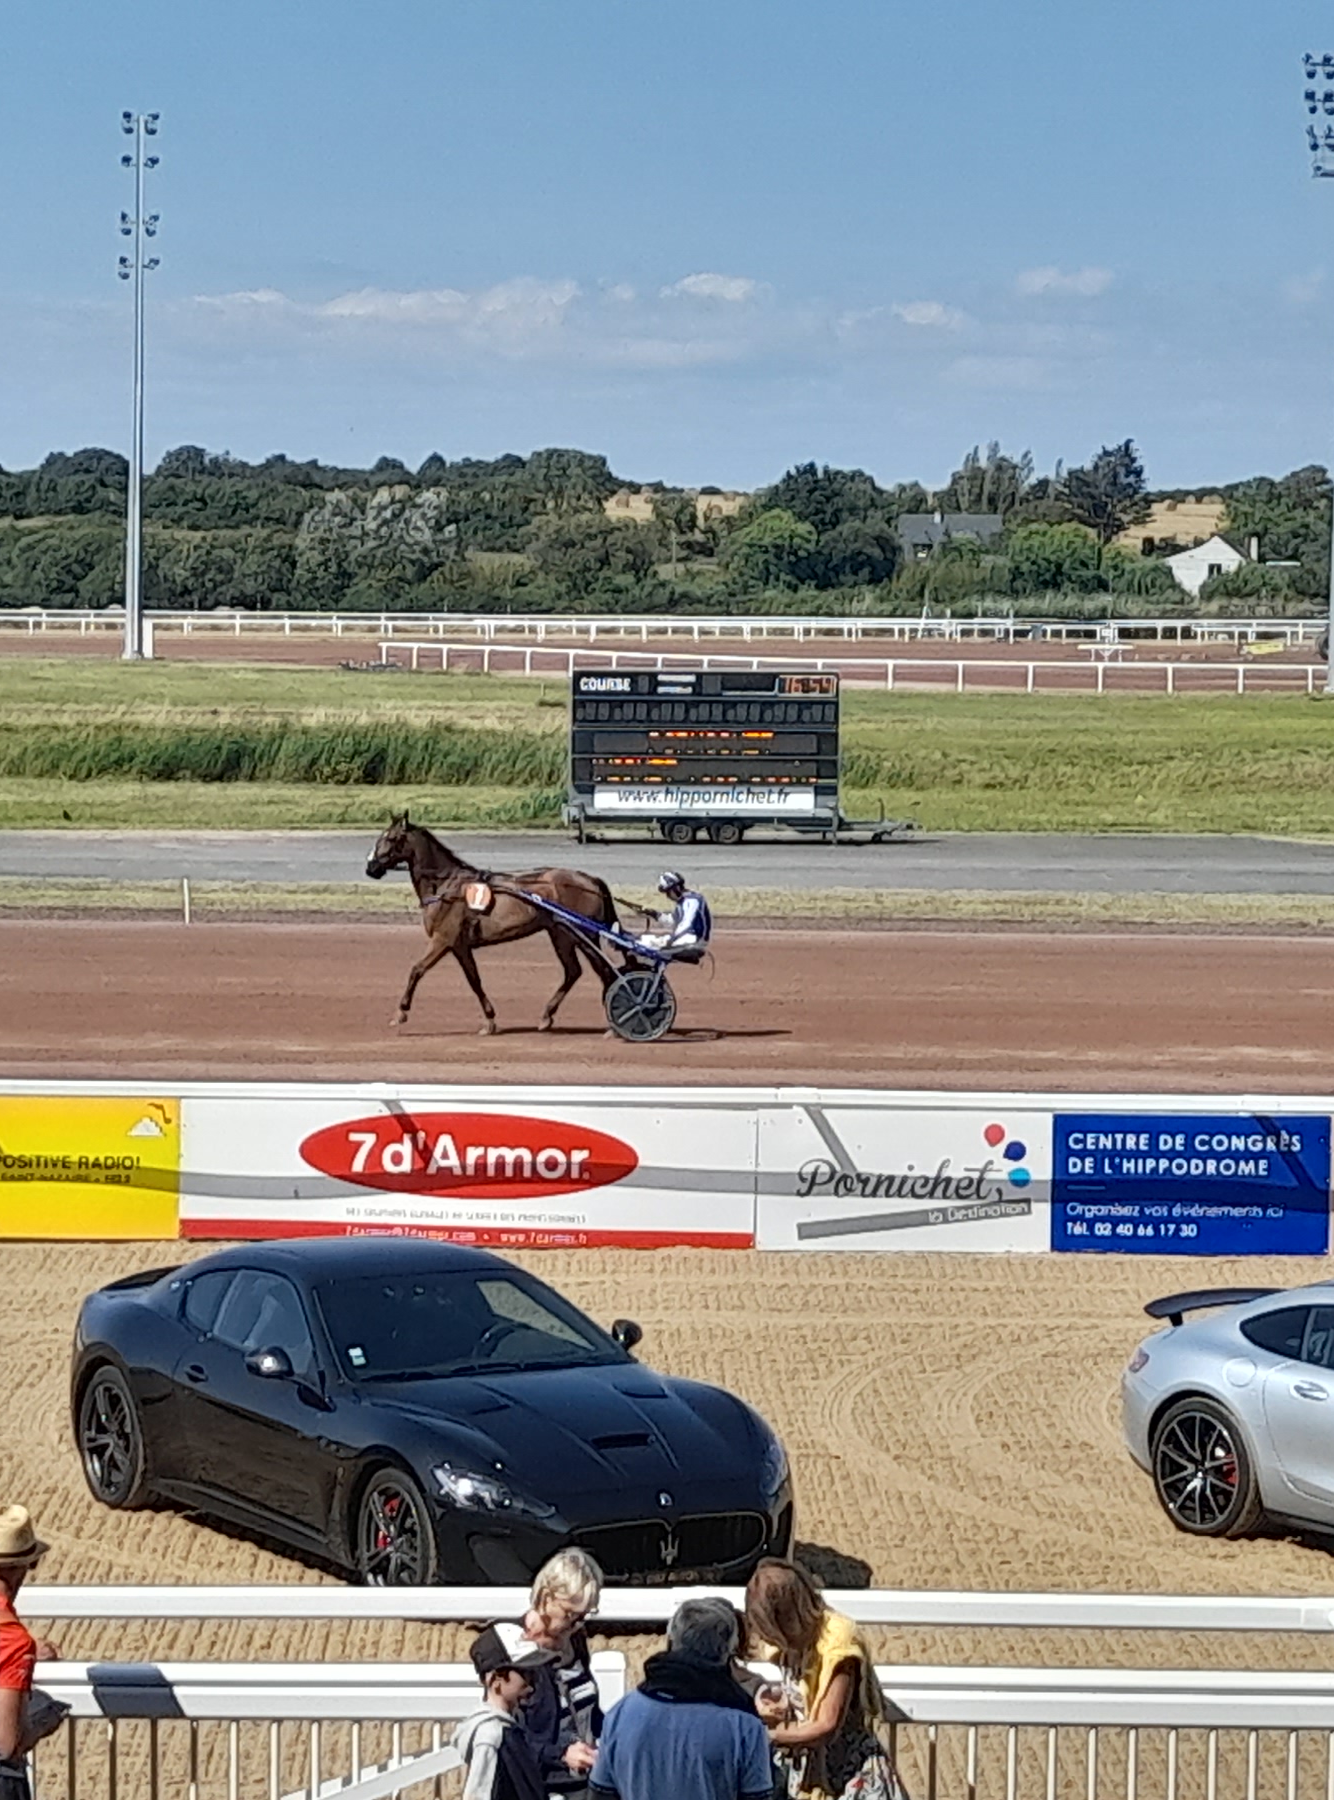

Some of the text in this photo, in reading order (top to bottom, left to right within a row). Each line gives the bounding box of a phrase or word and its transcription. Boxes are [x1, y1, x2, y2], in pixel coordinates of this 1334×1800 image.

[580, 676, 631, 692] COURSE
[617, 787, 791, 808] www.hippornichet.fr
[1068, 1130, 1302, 1152] CENTRE DE CONGRÈS
[78, 1155, 142, 1171] RADIO!
[1067, 1157, 1269, 1176] DE L'HIPPODROME
[1066, 1202, 1140, 1219] Organisez
[1143, 1205, 1168, 1216] vos
[1266, 1203, 1285, 1218] ici
[1094, 1222, 1113, 1236] 02
[1115, 1222, 1134, 1236] 40
[1136, 1223, 1155, 1237] 66
[1158, 1223, 1176, 1237] 17
[1179, 1223, 1198, 1238] 30
